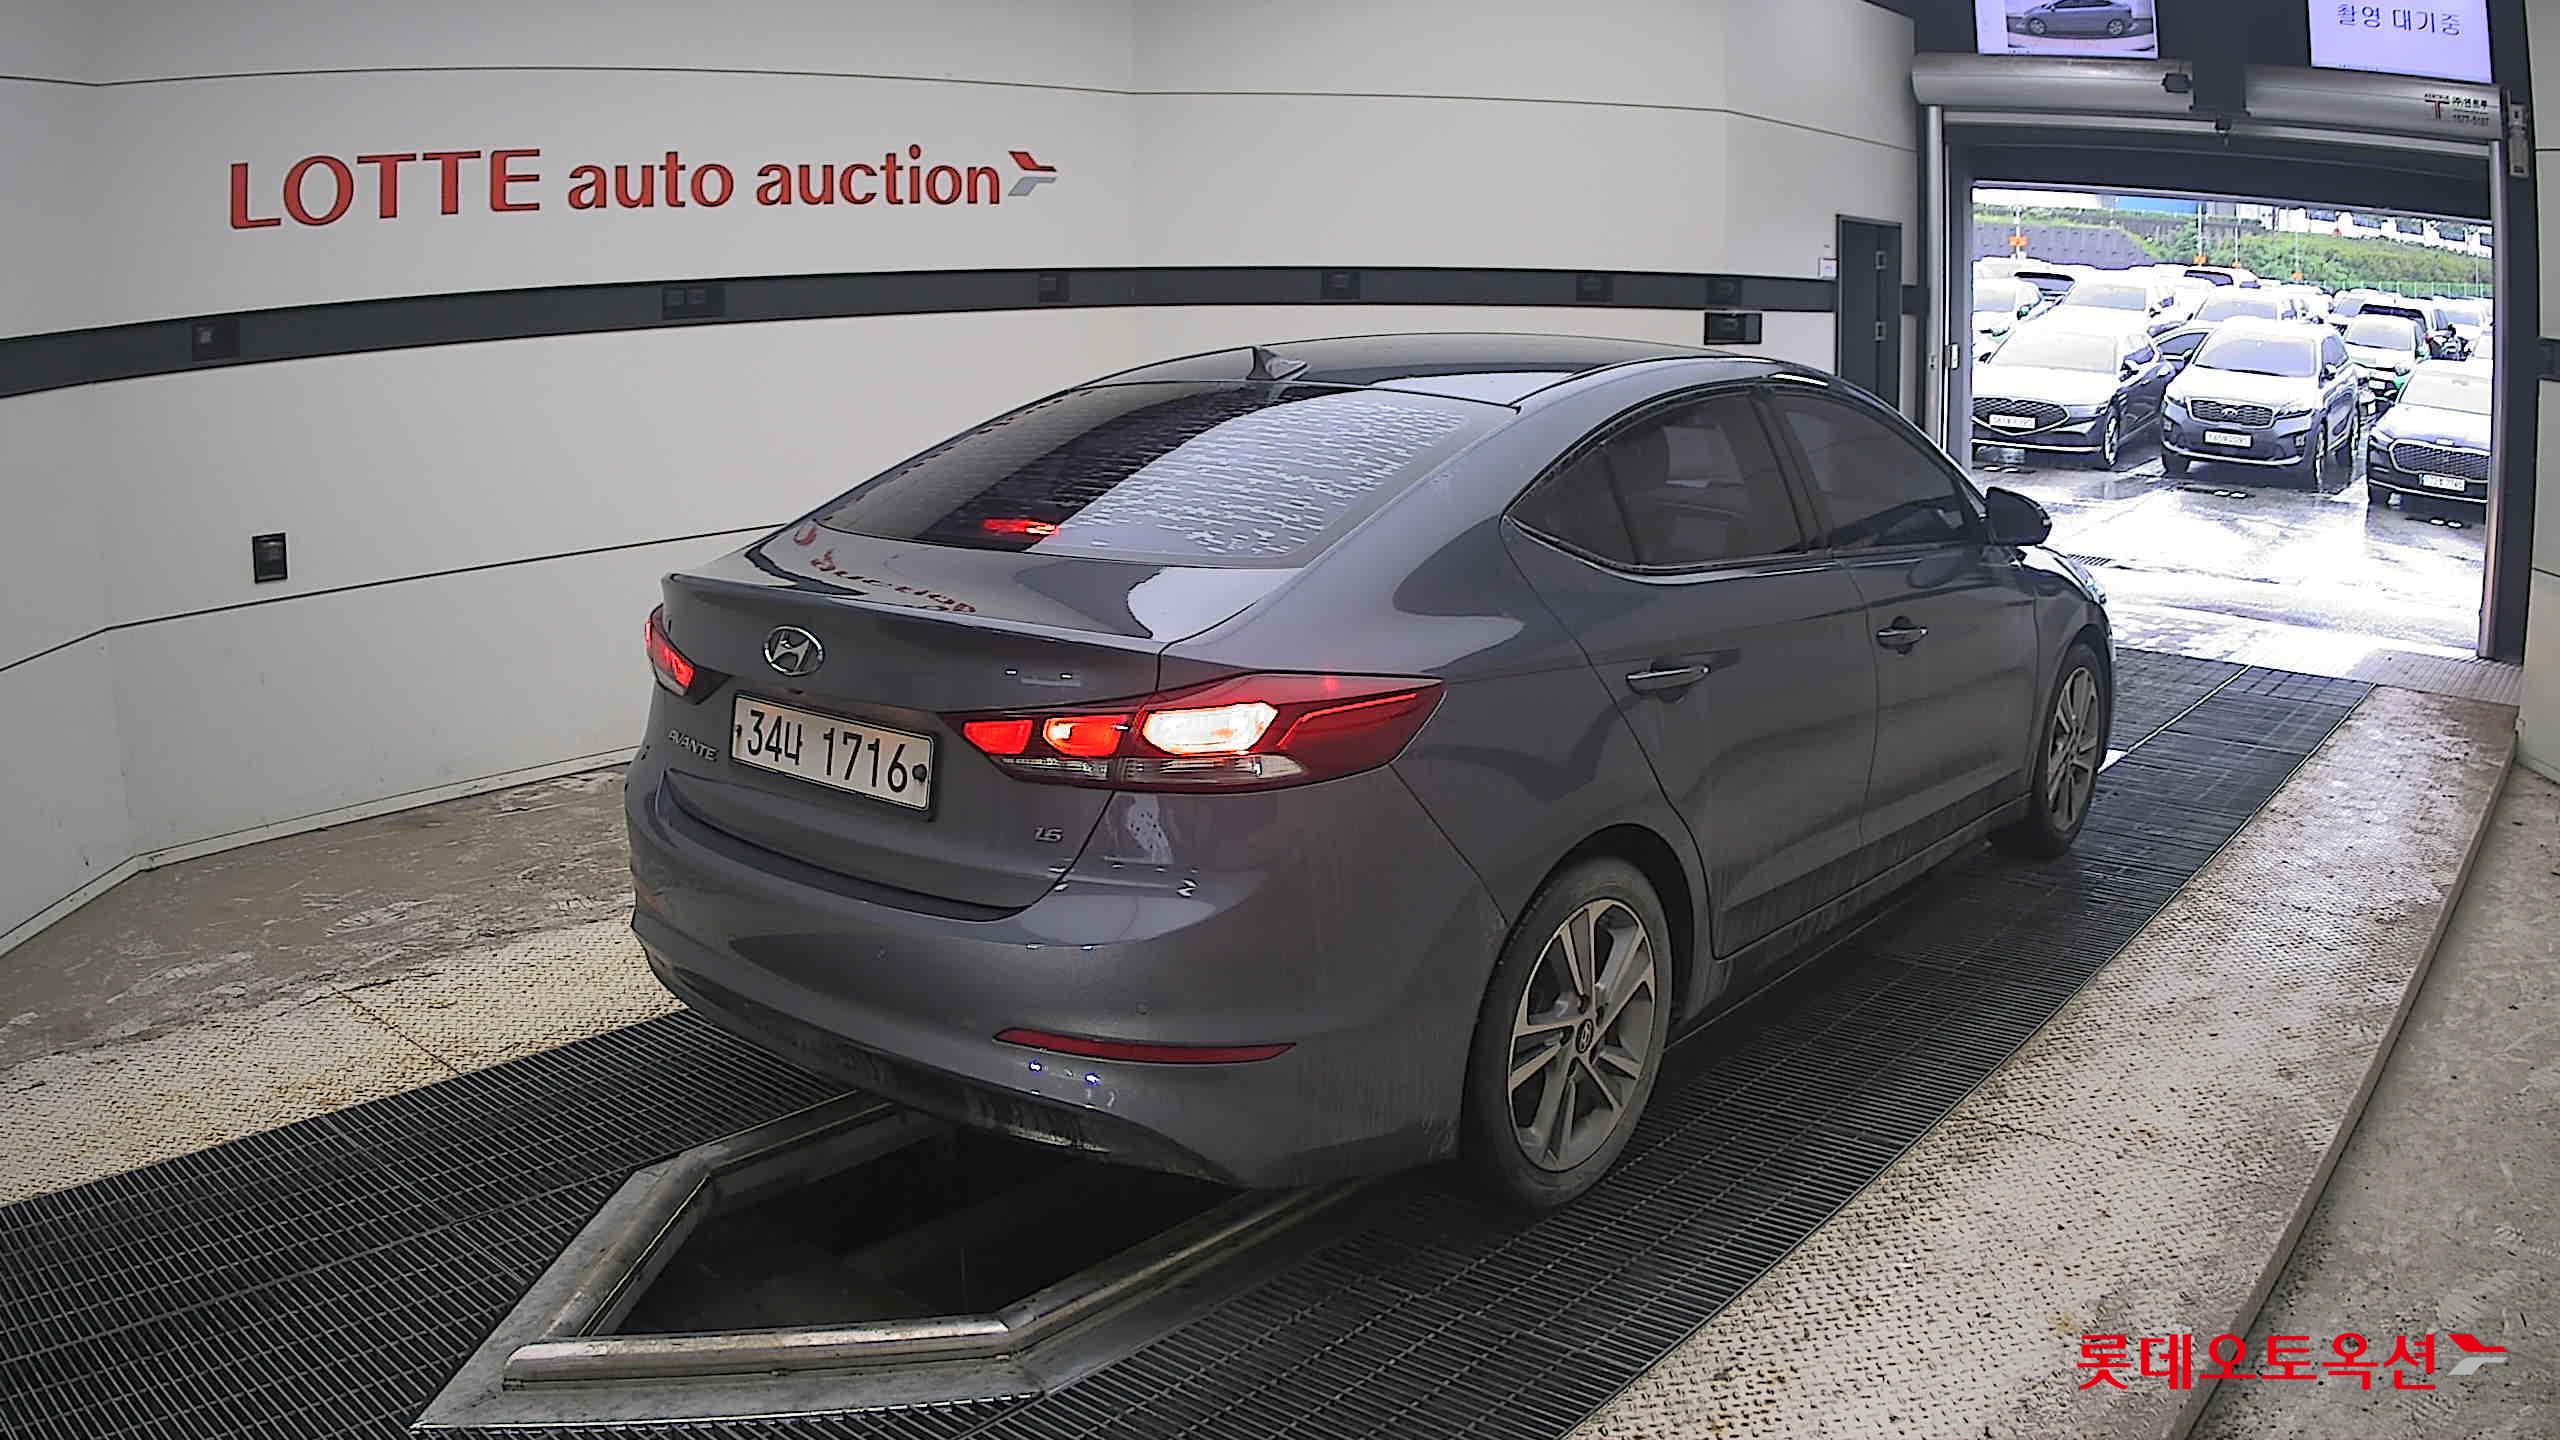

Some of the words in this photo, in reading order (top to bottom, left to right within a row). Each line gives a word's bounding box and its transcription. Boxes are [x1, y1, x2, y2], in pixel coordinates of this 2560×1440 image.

[2337, 4, 2382, 28] 촬영
[2392, 8, 2461, 36] 대기중
[229, 148, 541, 230] LOTTE
[567, 151, 735, 209] auto
[755, 144, 1002, 206] auction
[667, 728, 718, 761] AVANTE
[747, 709, 804, 766] 34나
[823, 727, 908, 793] 1716
